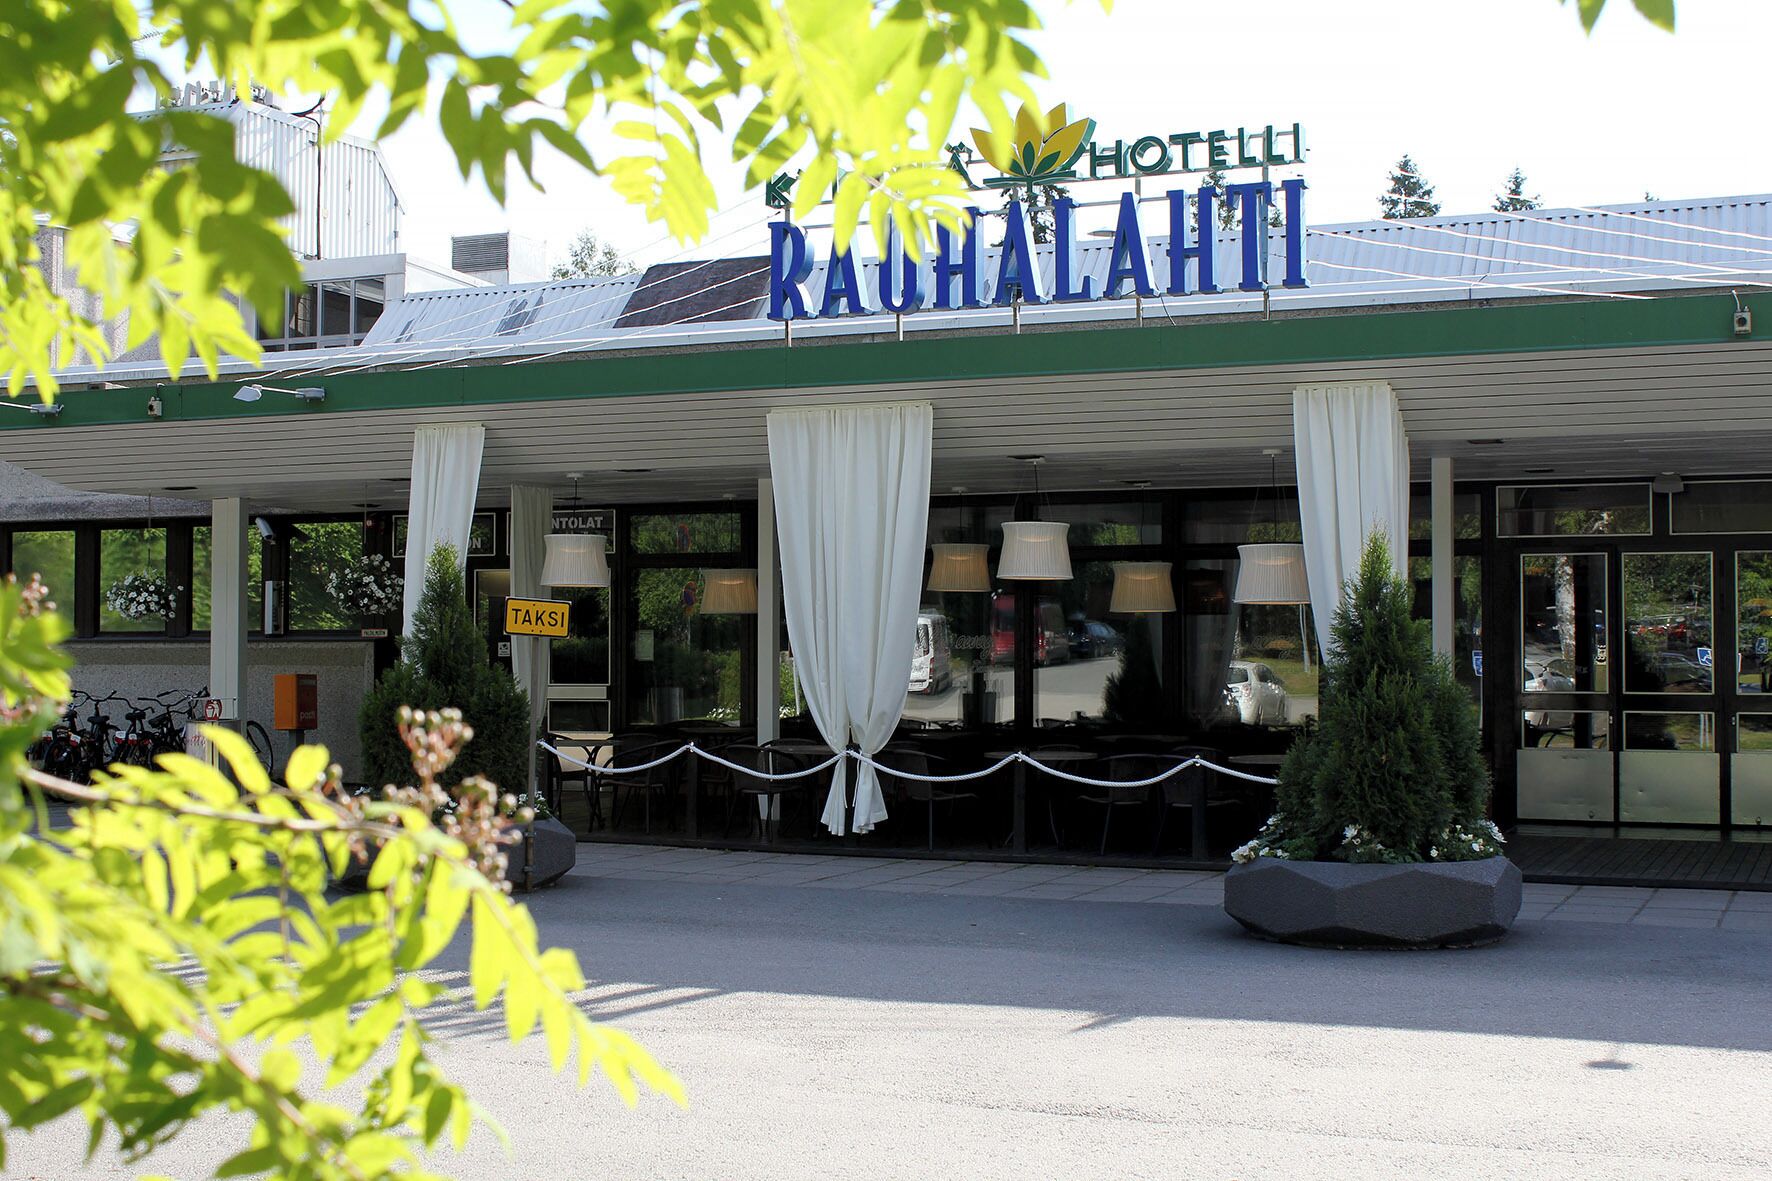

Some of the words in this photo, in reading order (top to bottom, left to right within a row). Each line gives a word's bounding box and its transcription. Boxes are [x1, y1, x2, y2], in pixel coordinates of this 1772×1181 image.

[1089, 122, 1306, 180] HOTELLI
[767, 178, 1311, 321] RAUHALAHTI
[511, 608, 565, 628] TAKSI
